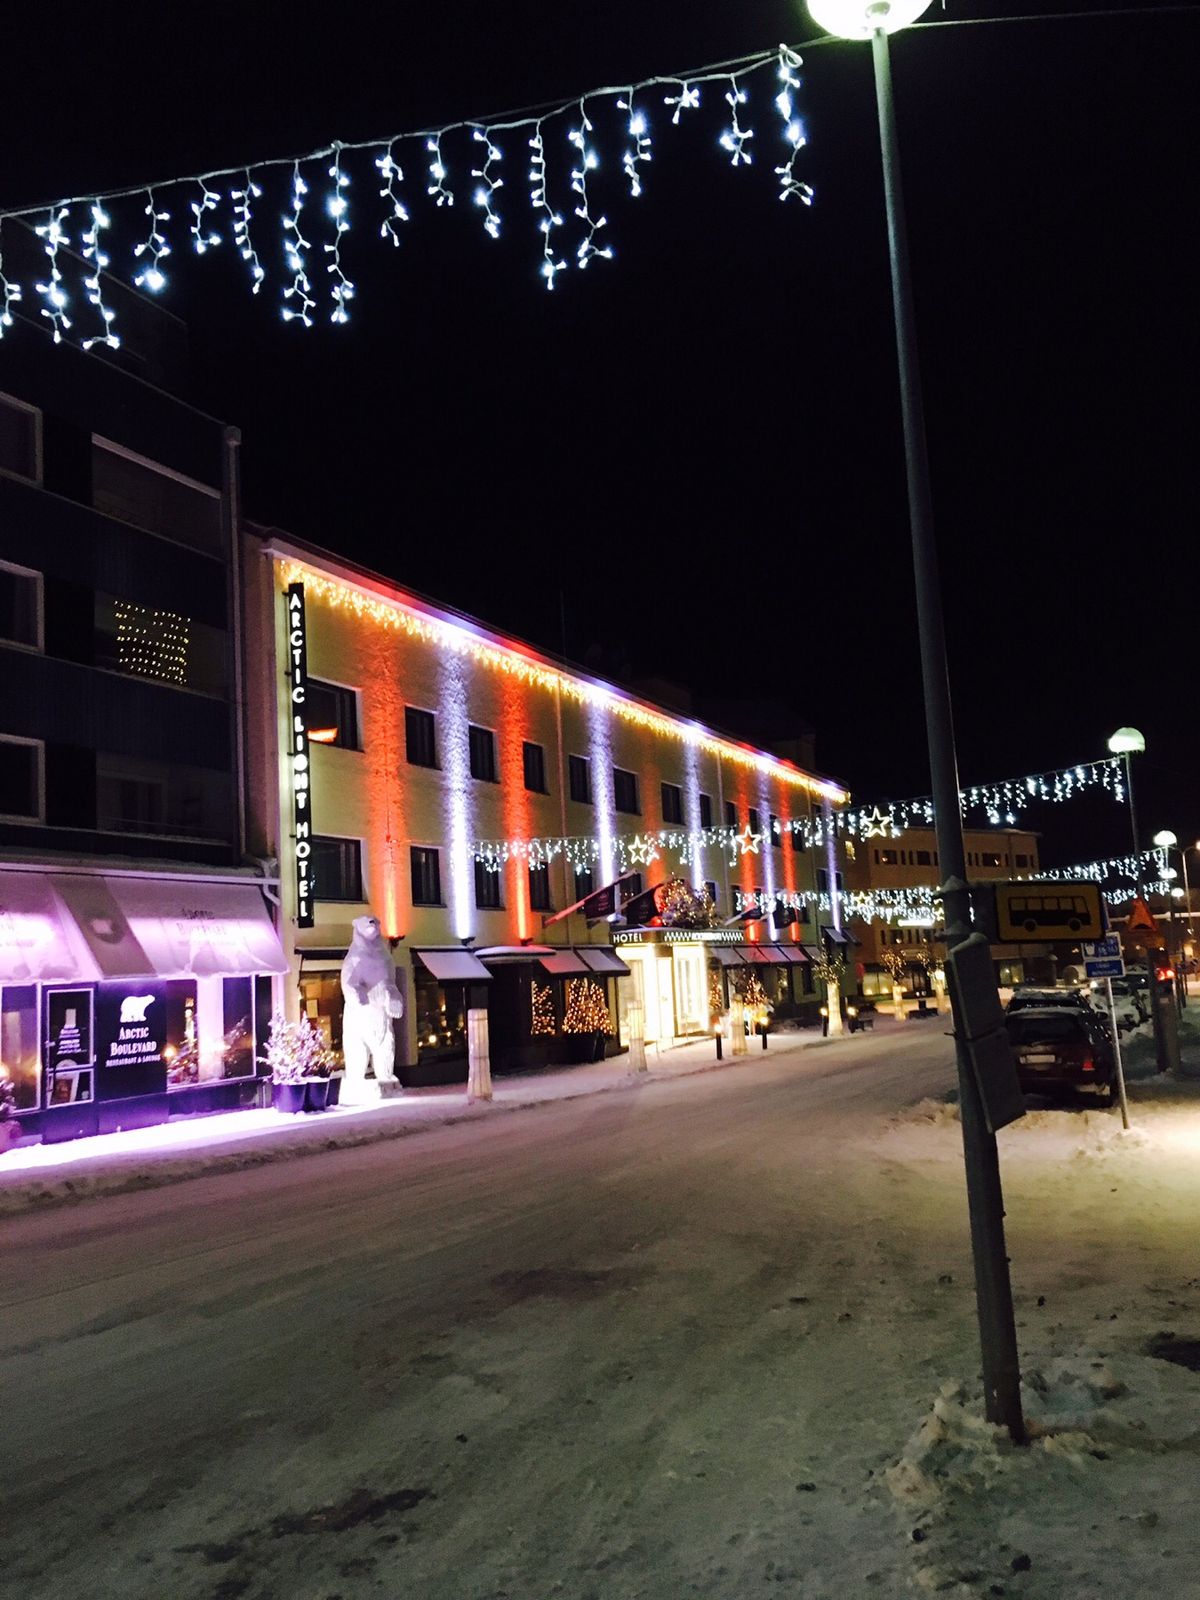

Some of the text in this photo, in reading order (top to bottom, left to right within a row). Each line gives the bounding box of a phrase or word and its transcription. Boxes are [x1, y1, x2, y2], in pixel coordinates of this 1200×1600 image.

[289, 592, 305, 703] ARCTIC
[296, 822, 311, 917] HOTEL
[613, 933, 643, 943] HOTEL
[118, 1026, 150, 1041] ARCTIC
[110, 1041, 157, 1057] BOULEVARD
